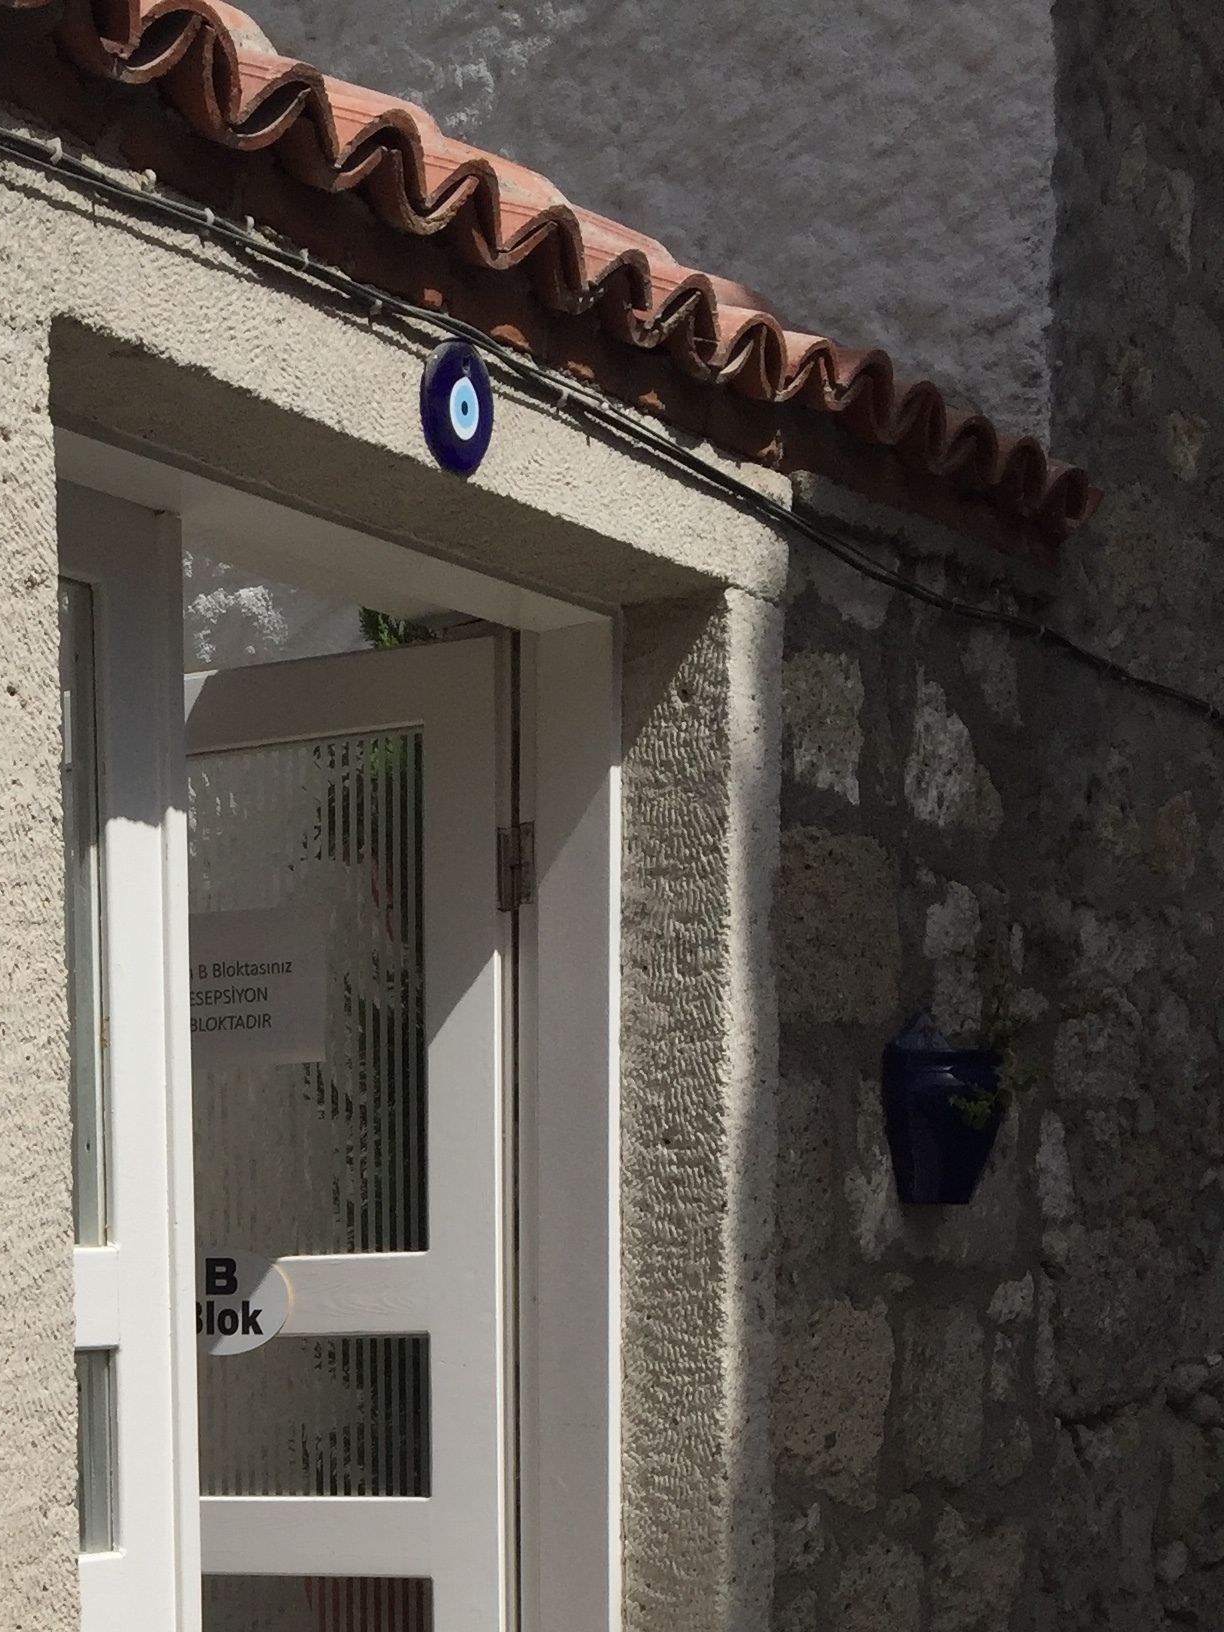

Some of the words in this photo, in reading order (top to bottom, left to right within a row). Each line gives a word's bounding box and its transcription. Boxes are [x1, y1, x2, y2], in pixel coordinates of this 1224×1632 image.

[198, 964, 208, 979] B
[212, 961, 292, 978] Bloktasınız
[205, 1257, 238, 1296] B
[196, 1300, 263, 1336] lok
